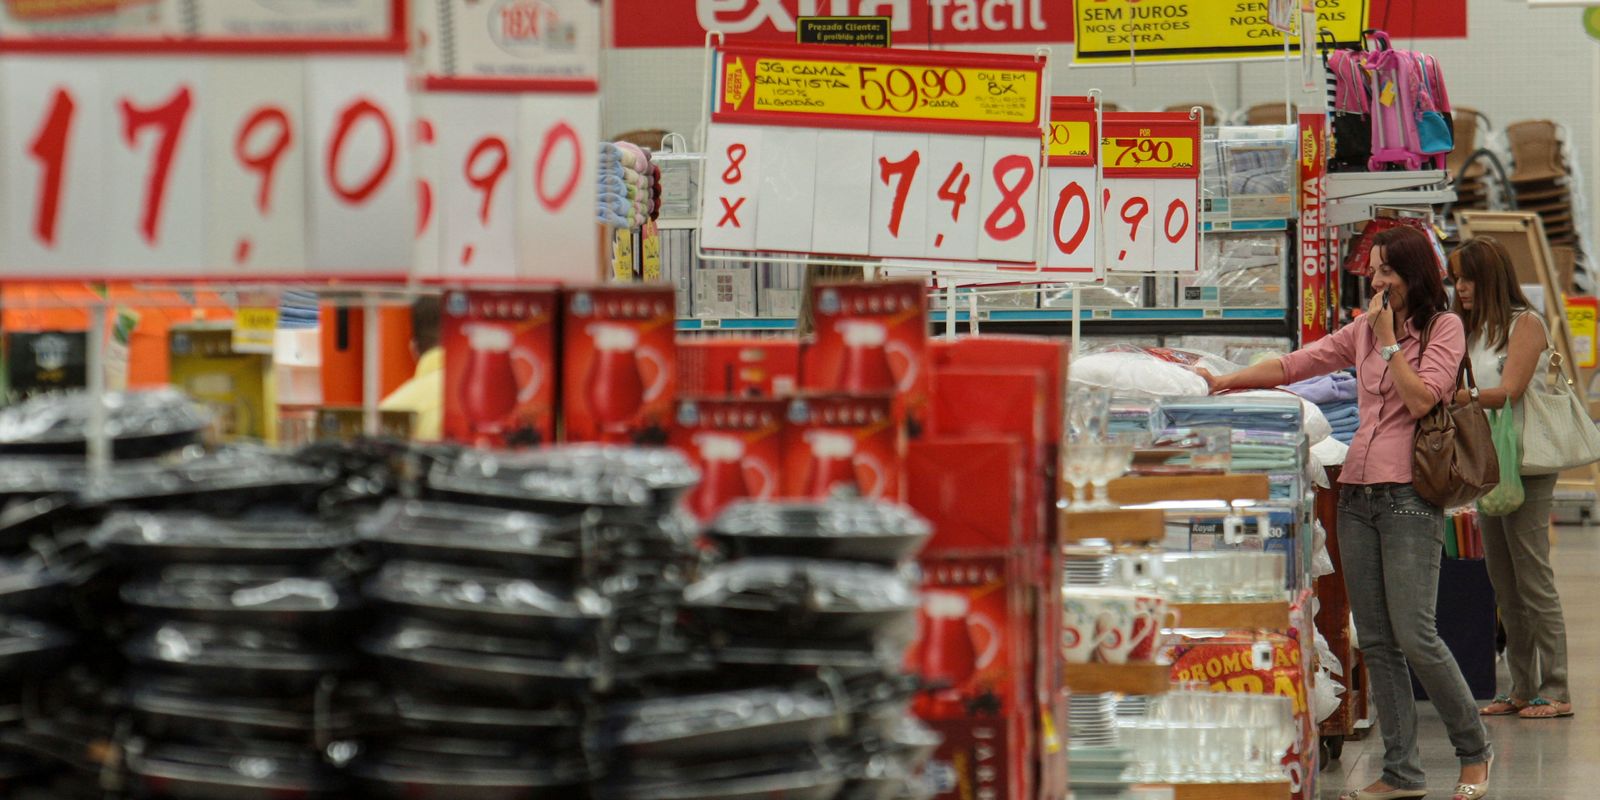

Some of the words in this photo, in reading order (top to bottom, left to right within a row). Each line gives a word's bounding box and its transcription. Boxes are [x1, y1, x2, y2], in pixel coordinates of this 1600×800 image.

[1084, 8, 1122, 21] SEM
[1130, 5, 1188, 19] JUROS
[1230, 16, 1267, 25] NOS
[808, 23, 843, 31] Prezado
[845, 23, 880, 31] Cliente:
[1086, 25, 1115, 33] NOS
[1121, 21, 1190, 32] CARTÕES
[1107, 34, 1164, 44] EXTRA
[792, 65, 846, 76] CAMA
[754, 75, 849, 88] SANTISTA
[977, 72, 995, 81] OU
[1001, 72, 1026, 81] EM
[1139, 128, 1151, 137] POR
[721, 143, 746, 184] 8
[1303, 177, 1318, 276] OFERTA
